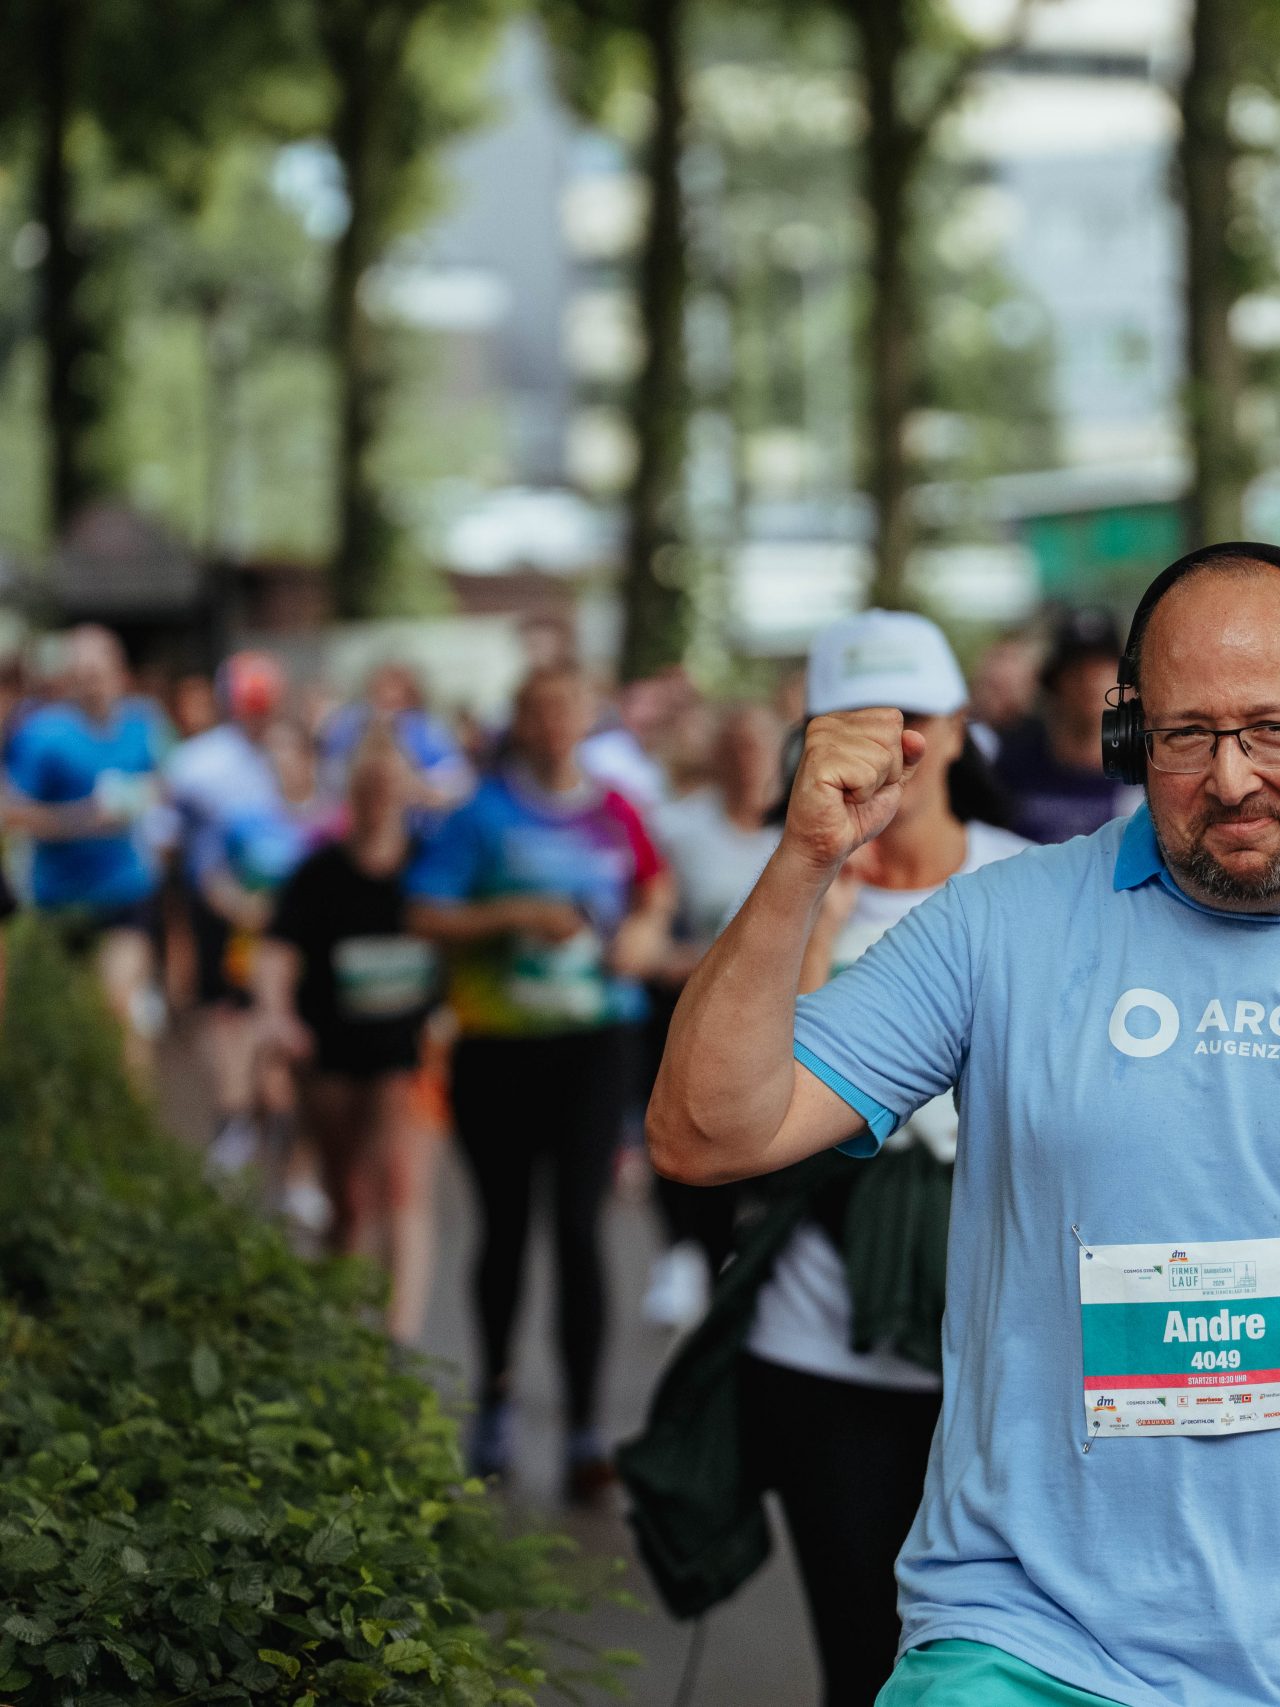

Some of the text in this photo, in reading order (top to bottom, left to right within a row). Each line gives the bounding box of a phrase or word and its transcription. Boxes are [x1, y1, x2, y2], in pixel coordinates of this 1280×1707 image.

[1171, 1249, 1187, 1258] dm
[1171, 1266, 1199, 1275] FIRMEN
[1172, 1276, 1199, 1288] LAUF
[1162, 1308, 1266, 1343] Andre
[1190, 1349, 1241, 1370] 4049
[1188, 1376, 1217, 1385] STARTZEIT
[1235, 1374, 1247, 1383] UHR
[1096, 1396, 1114, 1407] dm
